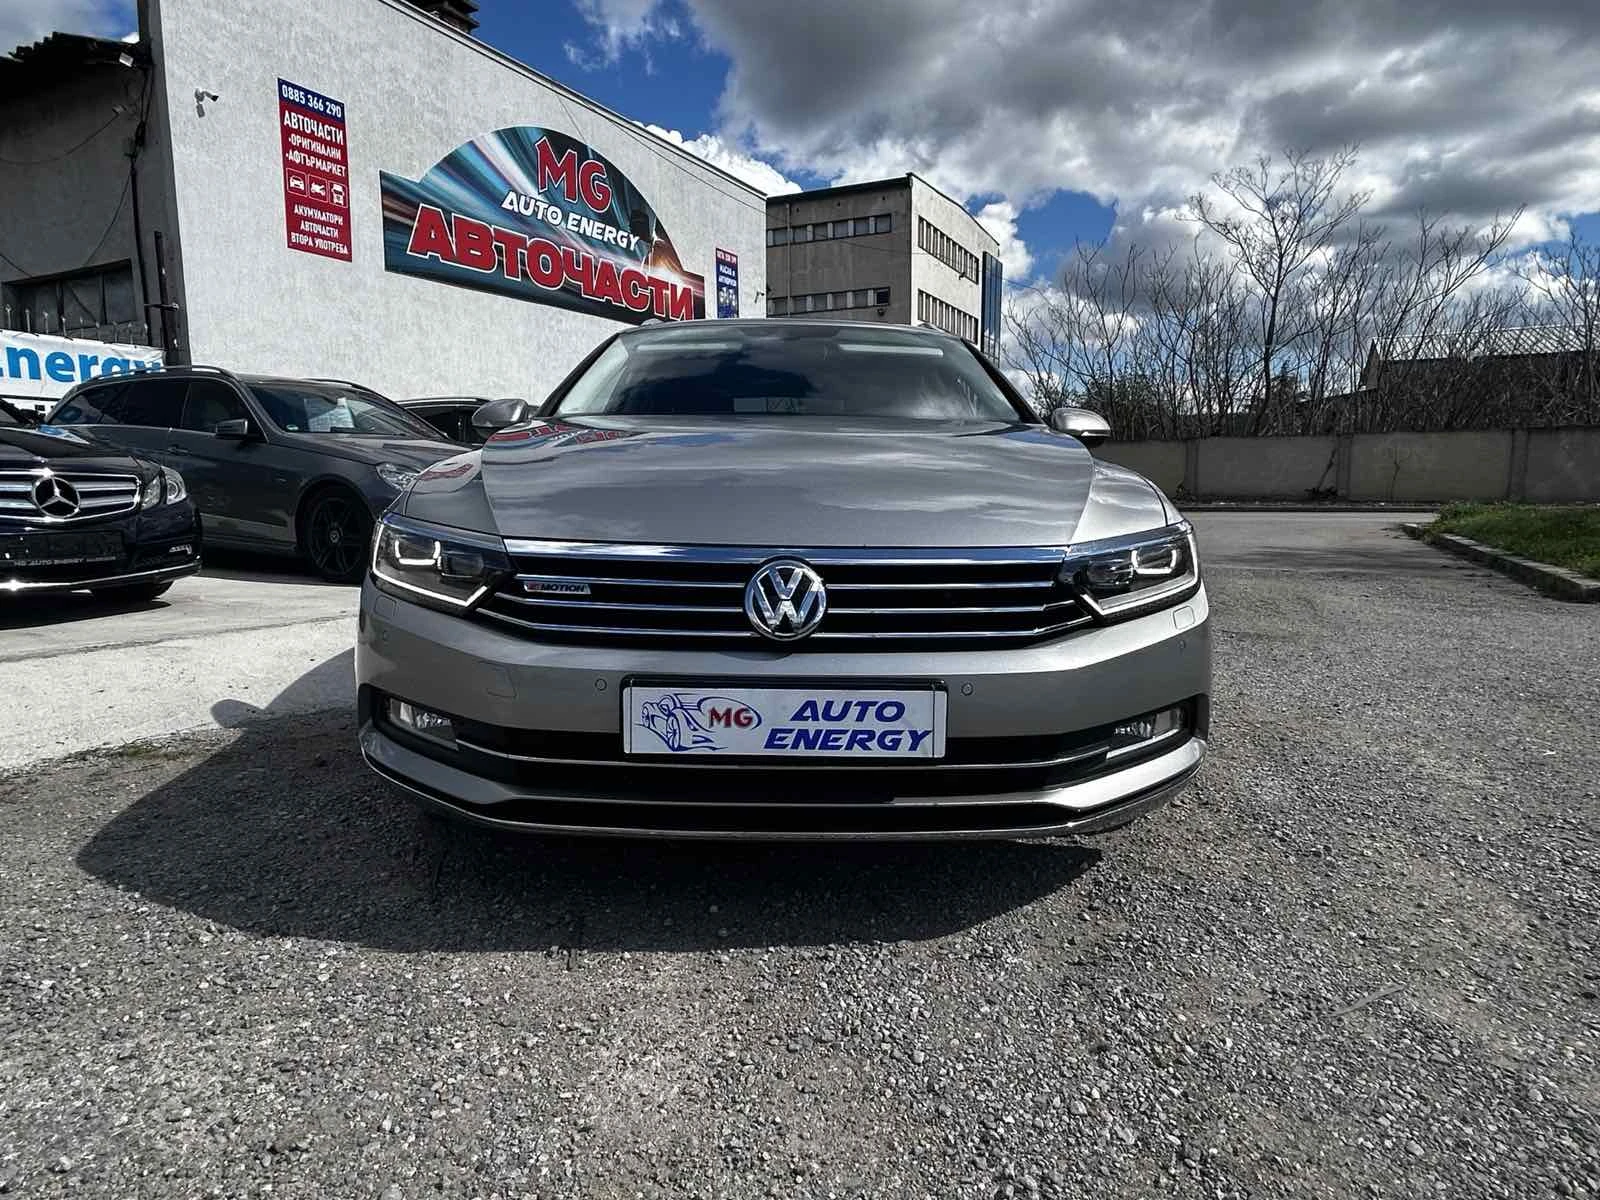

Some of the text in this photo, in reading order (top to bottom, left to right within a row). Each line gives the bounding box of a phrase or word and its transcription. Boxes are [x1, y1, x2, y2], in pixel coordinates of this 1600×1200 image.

[281, 84, 342, 118] 0885 366 290
[283, 110, 344, 145] АВТОЧАСТИ
[535, 136, 612, 214] MG
[300, 220, 339, 238] АВТОЧАСТИ
[501, 191, 640, 252] AUTO ENERGY
[290, 232, 348, 254] ВТОРА УПОТРЕБА
[407, 203, 695, 320] АВТОЧАСТИ
[708, 707, 753, 728] MG
[789, 700, 906, 723] AUTO
[763, 728, 933, 751] ENERGY
